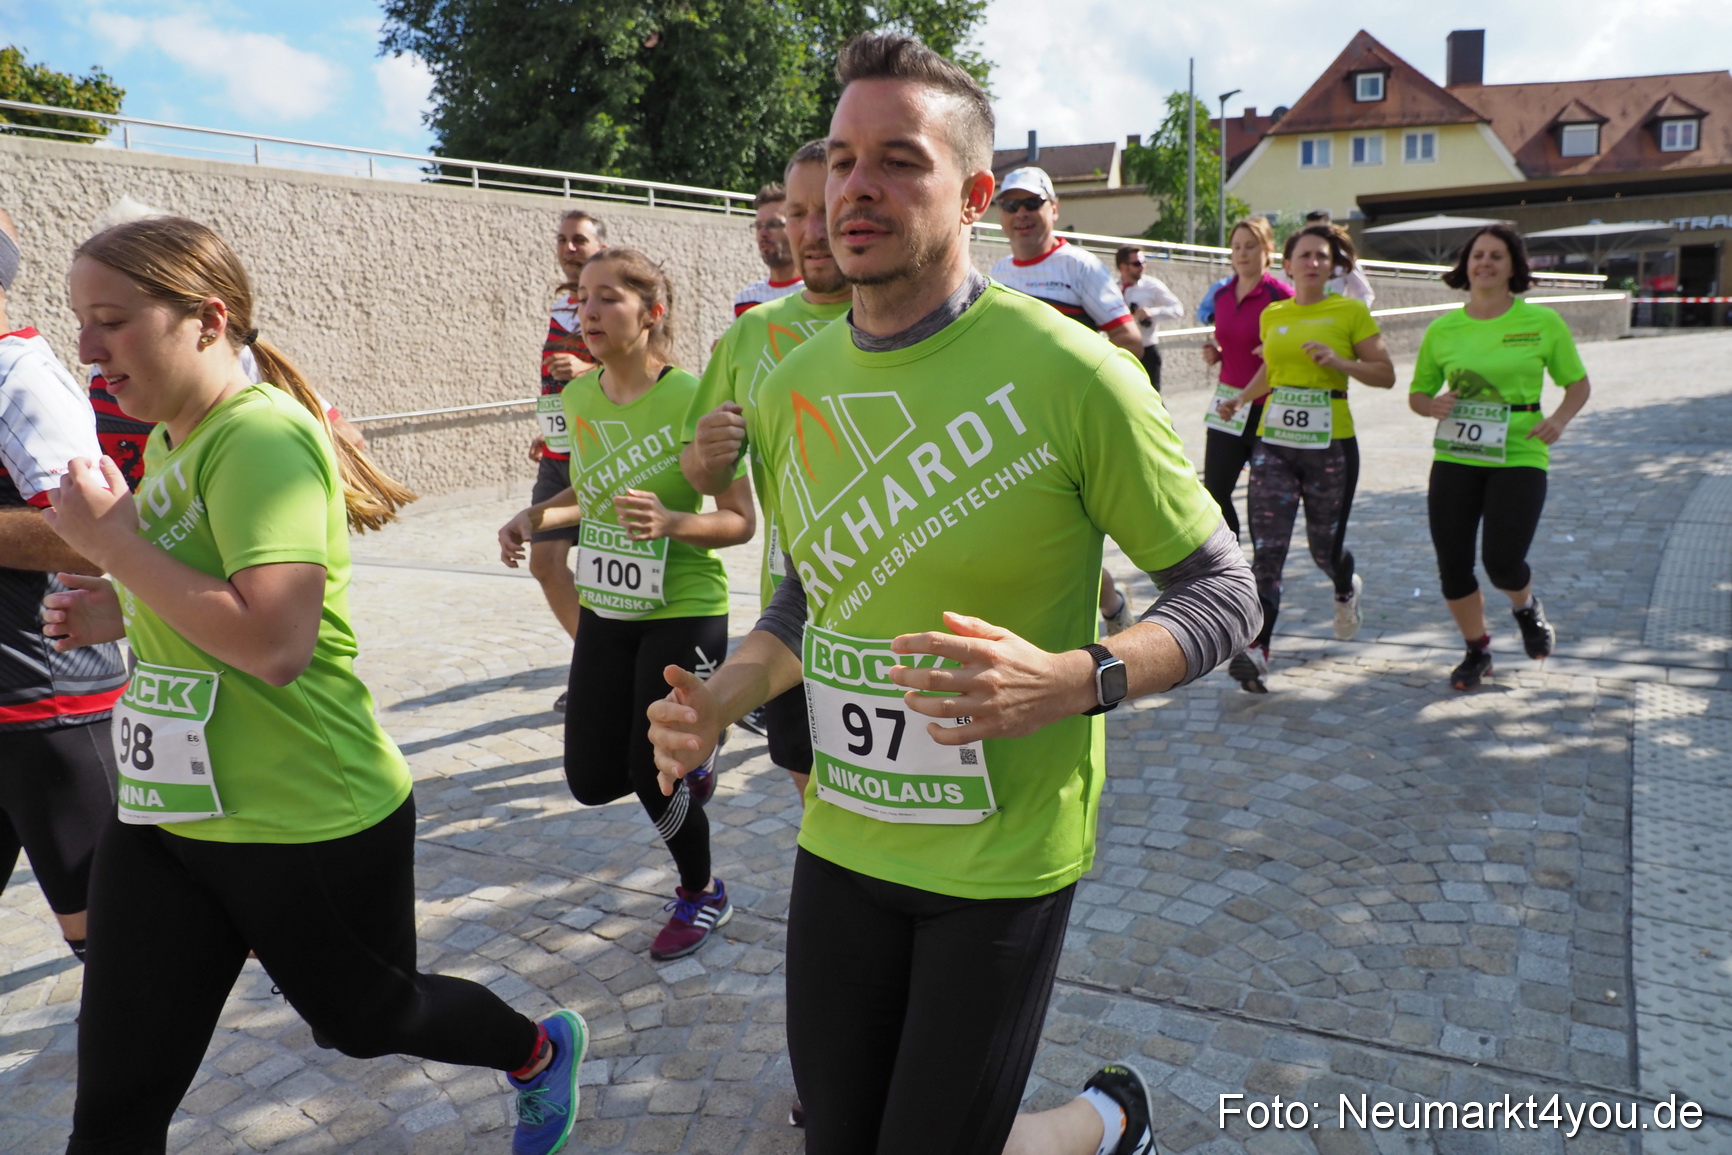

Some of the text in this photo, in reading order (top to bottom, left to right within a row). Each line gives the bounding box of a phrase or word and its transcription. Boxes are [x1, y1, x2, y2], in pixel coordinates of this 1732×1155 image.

[547, 416, 566, 432] 79
[1283, 409, 1309, 428] 68
[1446, 405, 1501, 422] OCK
[1274, 429, 1318, 441] RAMONA
[1455, 422, 1482, 441] 70
[838, 442, 1058, 620] UND GEBÄUDETECHNIK
[592, 557, 641, 590] 100
[581, 589, 655, 610] FRANZISKA
[187, 734, 200, 744] E6
[842, 703, 906, 762] 97
[120, 717, 154, 771] 98
[827, 763, 965, 804] NIKOLAUS
[119, 782, 165, 808] NNA
